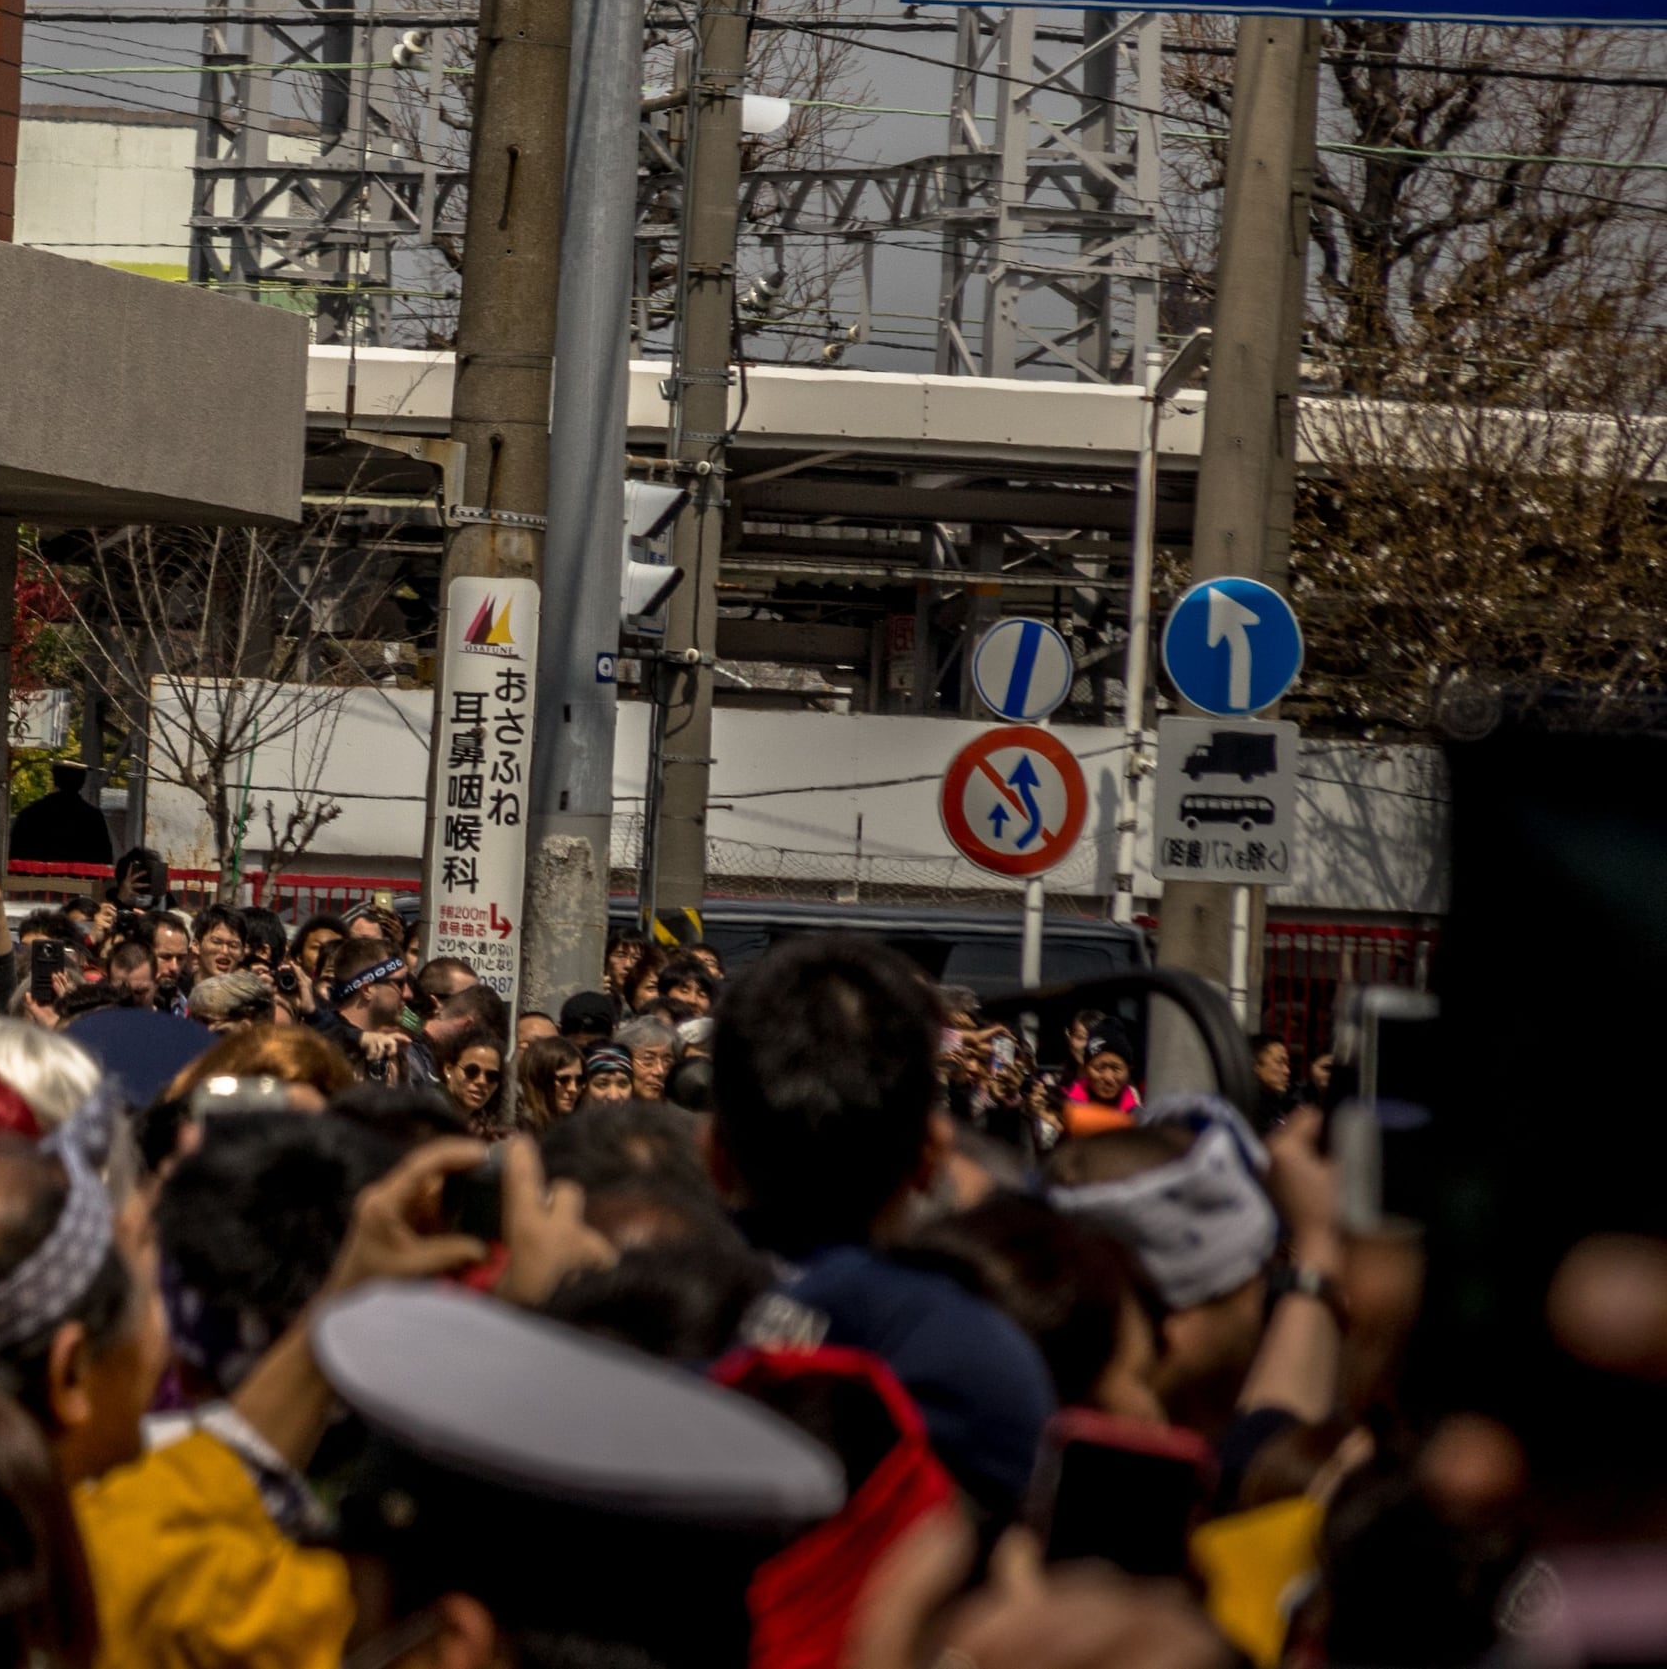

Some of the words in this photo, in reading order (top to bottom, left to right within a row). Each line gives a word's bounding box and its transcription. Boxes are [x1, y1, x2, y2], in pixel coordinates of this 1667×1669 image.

[465, 645, 514, 655] OSAFUNE
[442, 691, 489, 894] 耳鼻咽喉科
[487, 667, 527, 826] おさふね
